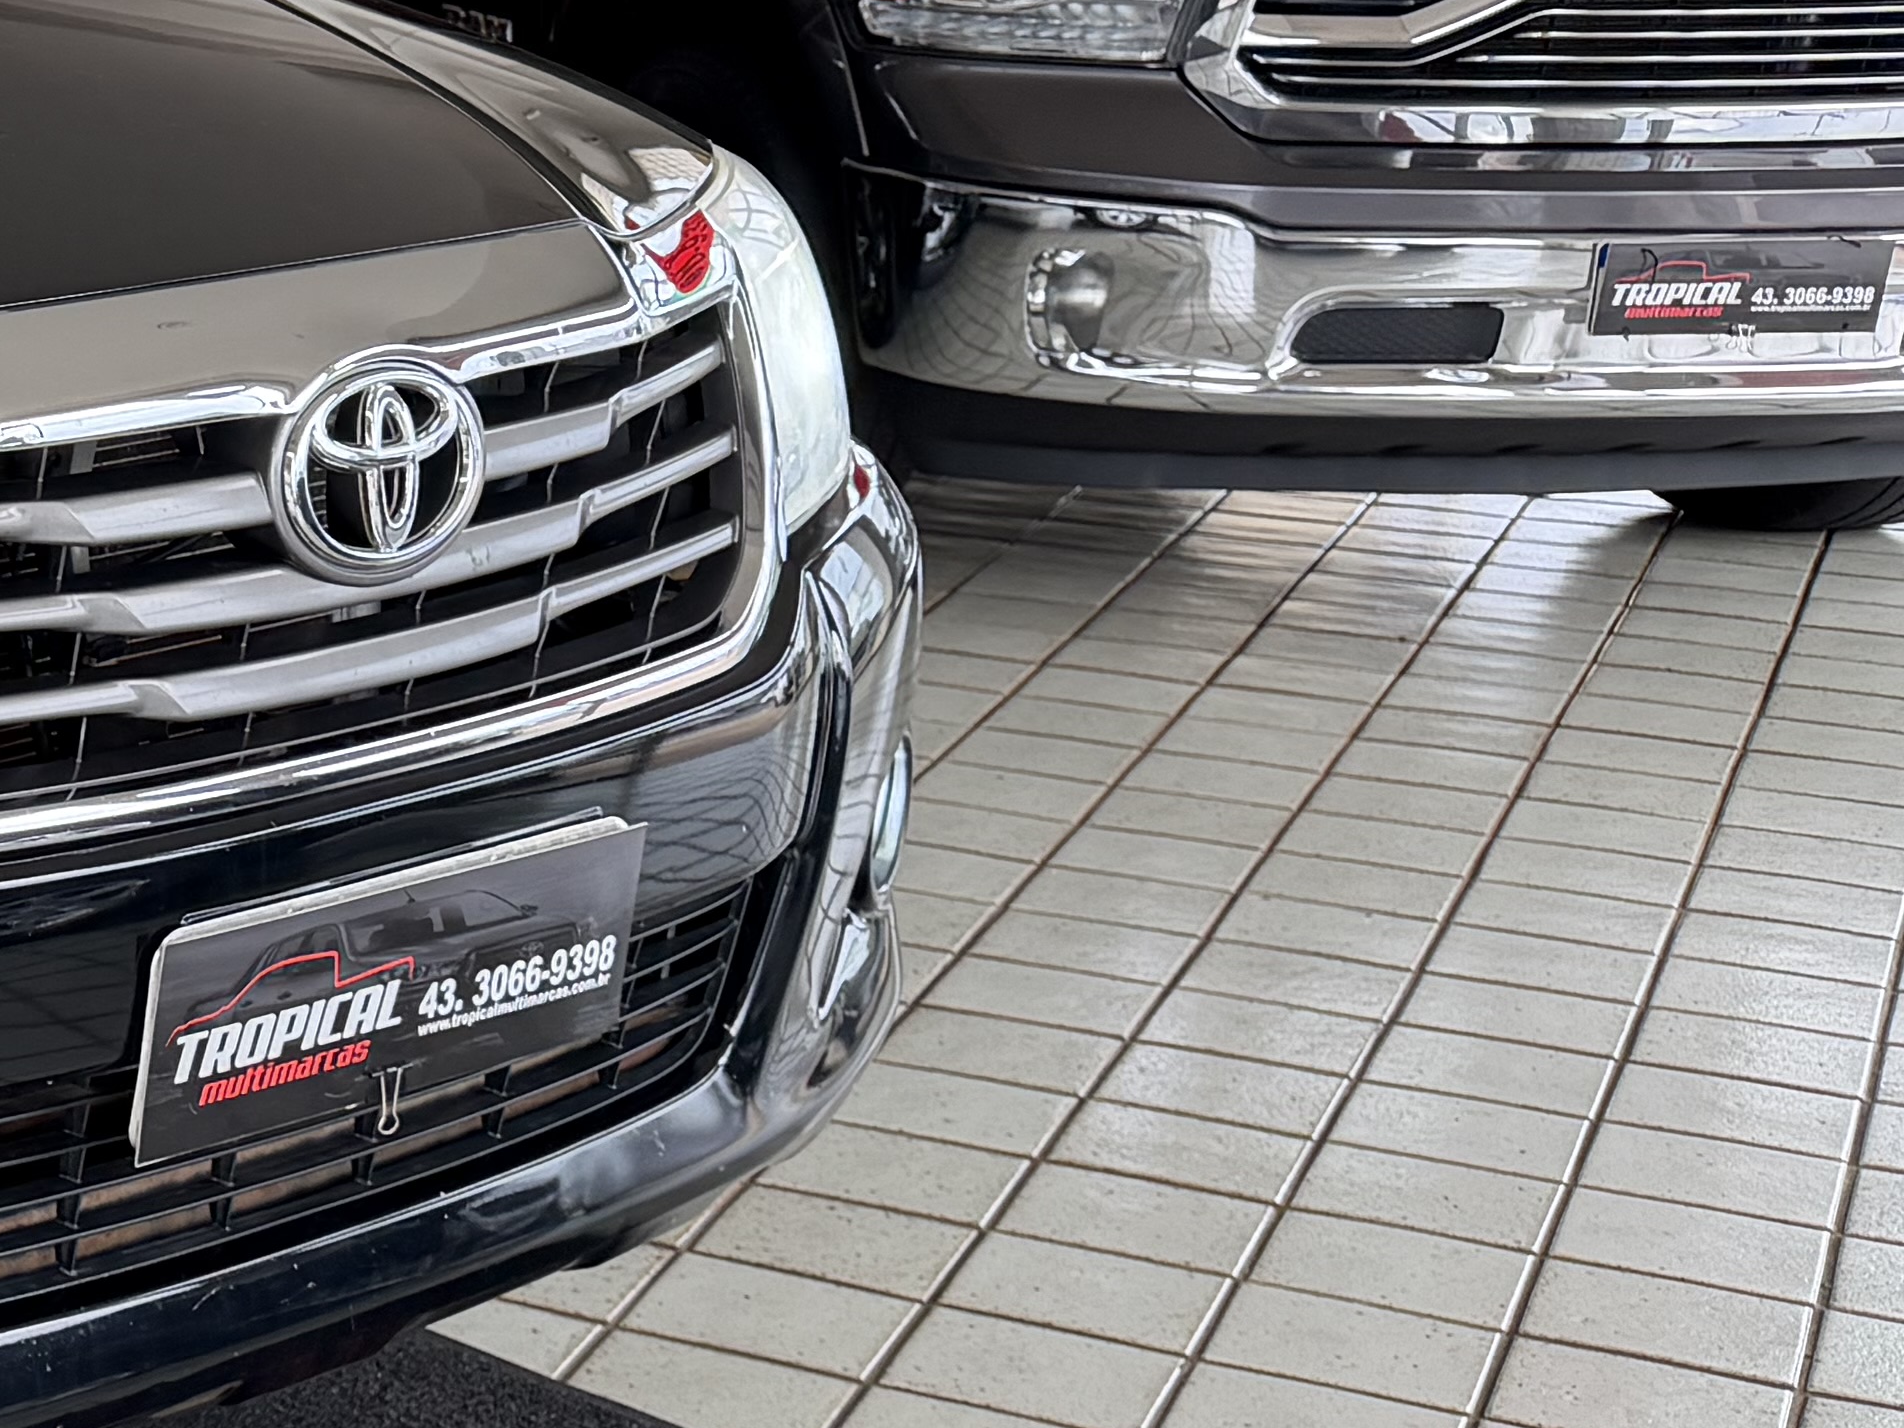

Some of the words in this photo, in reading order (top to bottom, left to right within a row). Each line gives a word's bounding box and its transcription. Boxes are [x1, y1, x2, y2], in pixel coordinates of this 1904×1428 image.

[1611, 281, 1743, 307] TROPICAL
[1783, 285, 1876, 305] 3066-9398
[418, 977, 464, 1020] 43.
[472, 934, 618, 1007] 3066-9398
[173, 978, 403, 1085] TROPICAL
[198, 1039, 372, 1107] multimarcas
